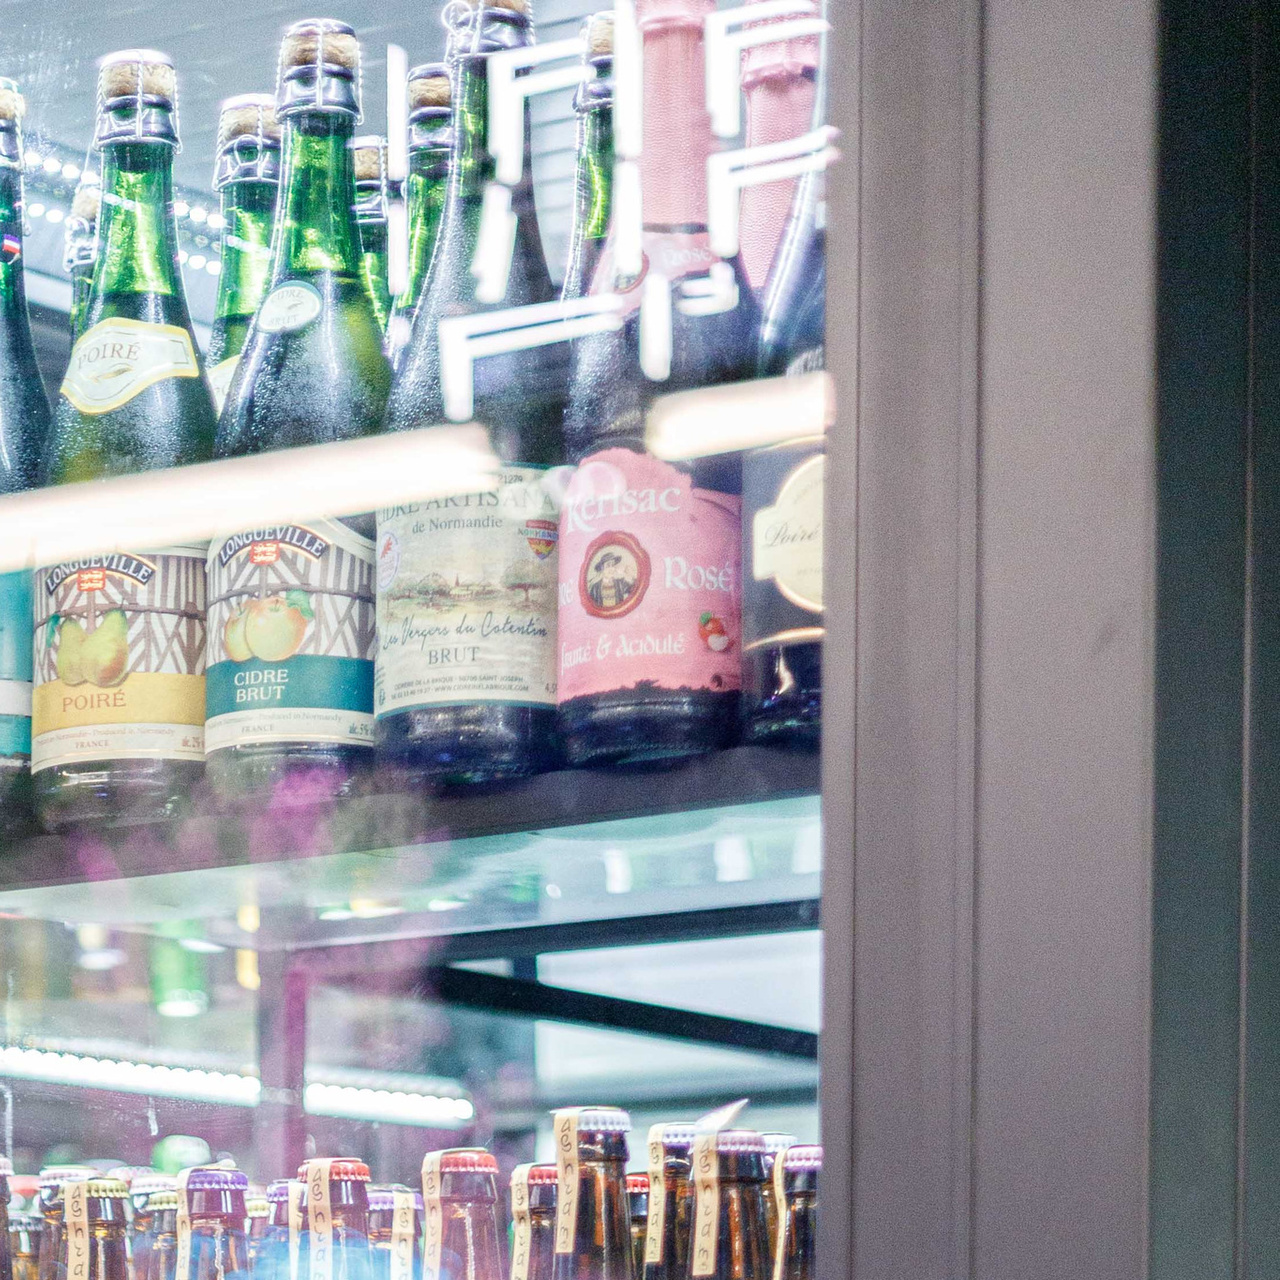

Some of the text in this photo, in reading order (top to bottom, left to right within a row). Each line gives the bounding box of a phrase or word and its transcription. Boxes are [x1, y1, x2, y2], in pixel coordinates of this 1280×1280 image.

[77, 341, 141, 370] POIRÉ
[412, 515, 503, 535] de Normandie
[221, 526, 326, 563] LONGUEVILLE
[47, 550, 156, 592] LONGUEVILLE
[662, 555, 736, 592] Rosé
[401, 610, 548, 650] Vergers du Cotentin
[428, 645, 480, 666] BRUT
[234, 669, 289, 687] CIDRE
[62, 689, 127, 712] POIRÉ
[235, 685, 286, 703] BRUT
